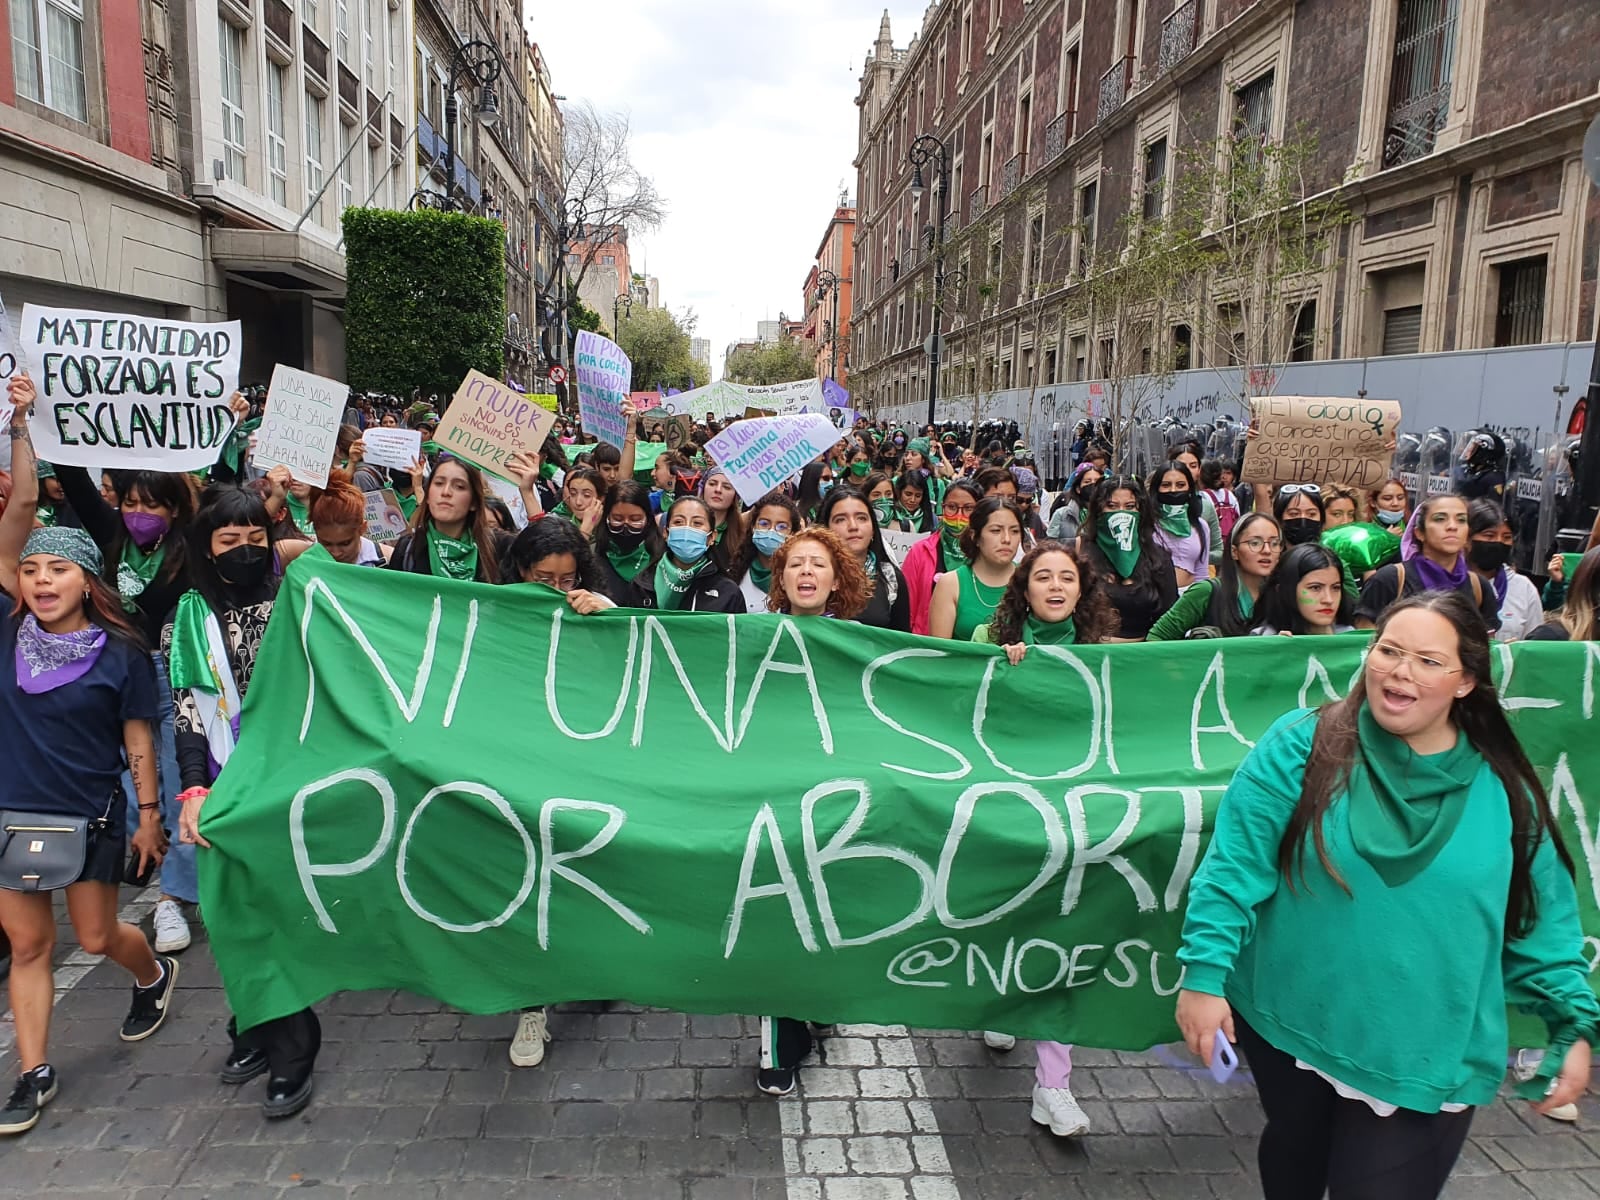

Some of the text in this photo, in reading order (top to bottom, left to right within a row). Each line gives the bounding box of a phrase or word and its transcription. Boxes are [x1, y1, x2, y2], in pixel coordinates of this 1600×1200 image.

[37, 316, 230, 358] MATERNIDAD
[578, 352, 597, 367] POR
[43, 353, 225, 399] FORZADA ES
[280, 376, 332, 403] UNA VIDA
[273, 399, 287, 416] NO
[475, 406, 497, 424] NO
[1270, 398, 1383, 424] El aborto
[53, 402, 238, 450] ESCLAVITUD
[280, 425, 328, 450] SOLO CON
[260, 441, 327, 474] DEJARLA NACER
[1329, 442, 1344, 457] la
[758, 439, 820, 489] DECIDIR
[1273, 458, 1384, 486] LIBERTAD
[1401, 474, 1417, 489] POLICI
[1519, 481, 1542, 497] POLICIA
[299, 576, 478, 744] NI
[545, 606, 835, 755] UNA
[289, 766, 1230, 959] POR ABORT
[886, 936, 1187, 996] @NOESU
